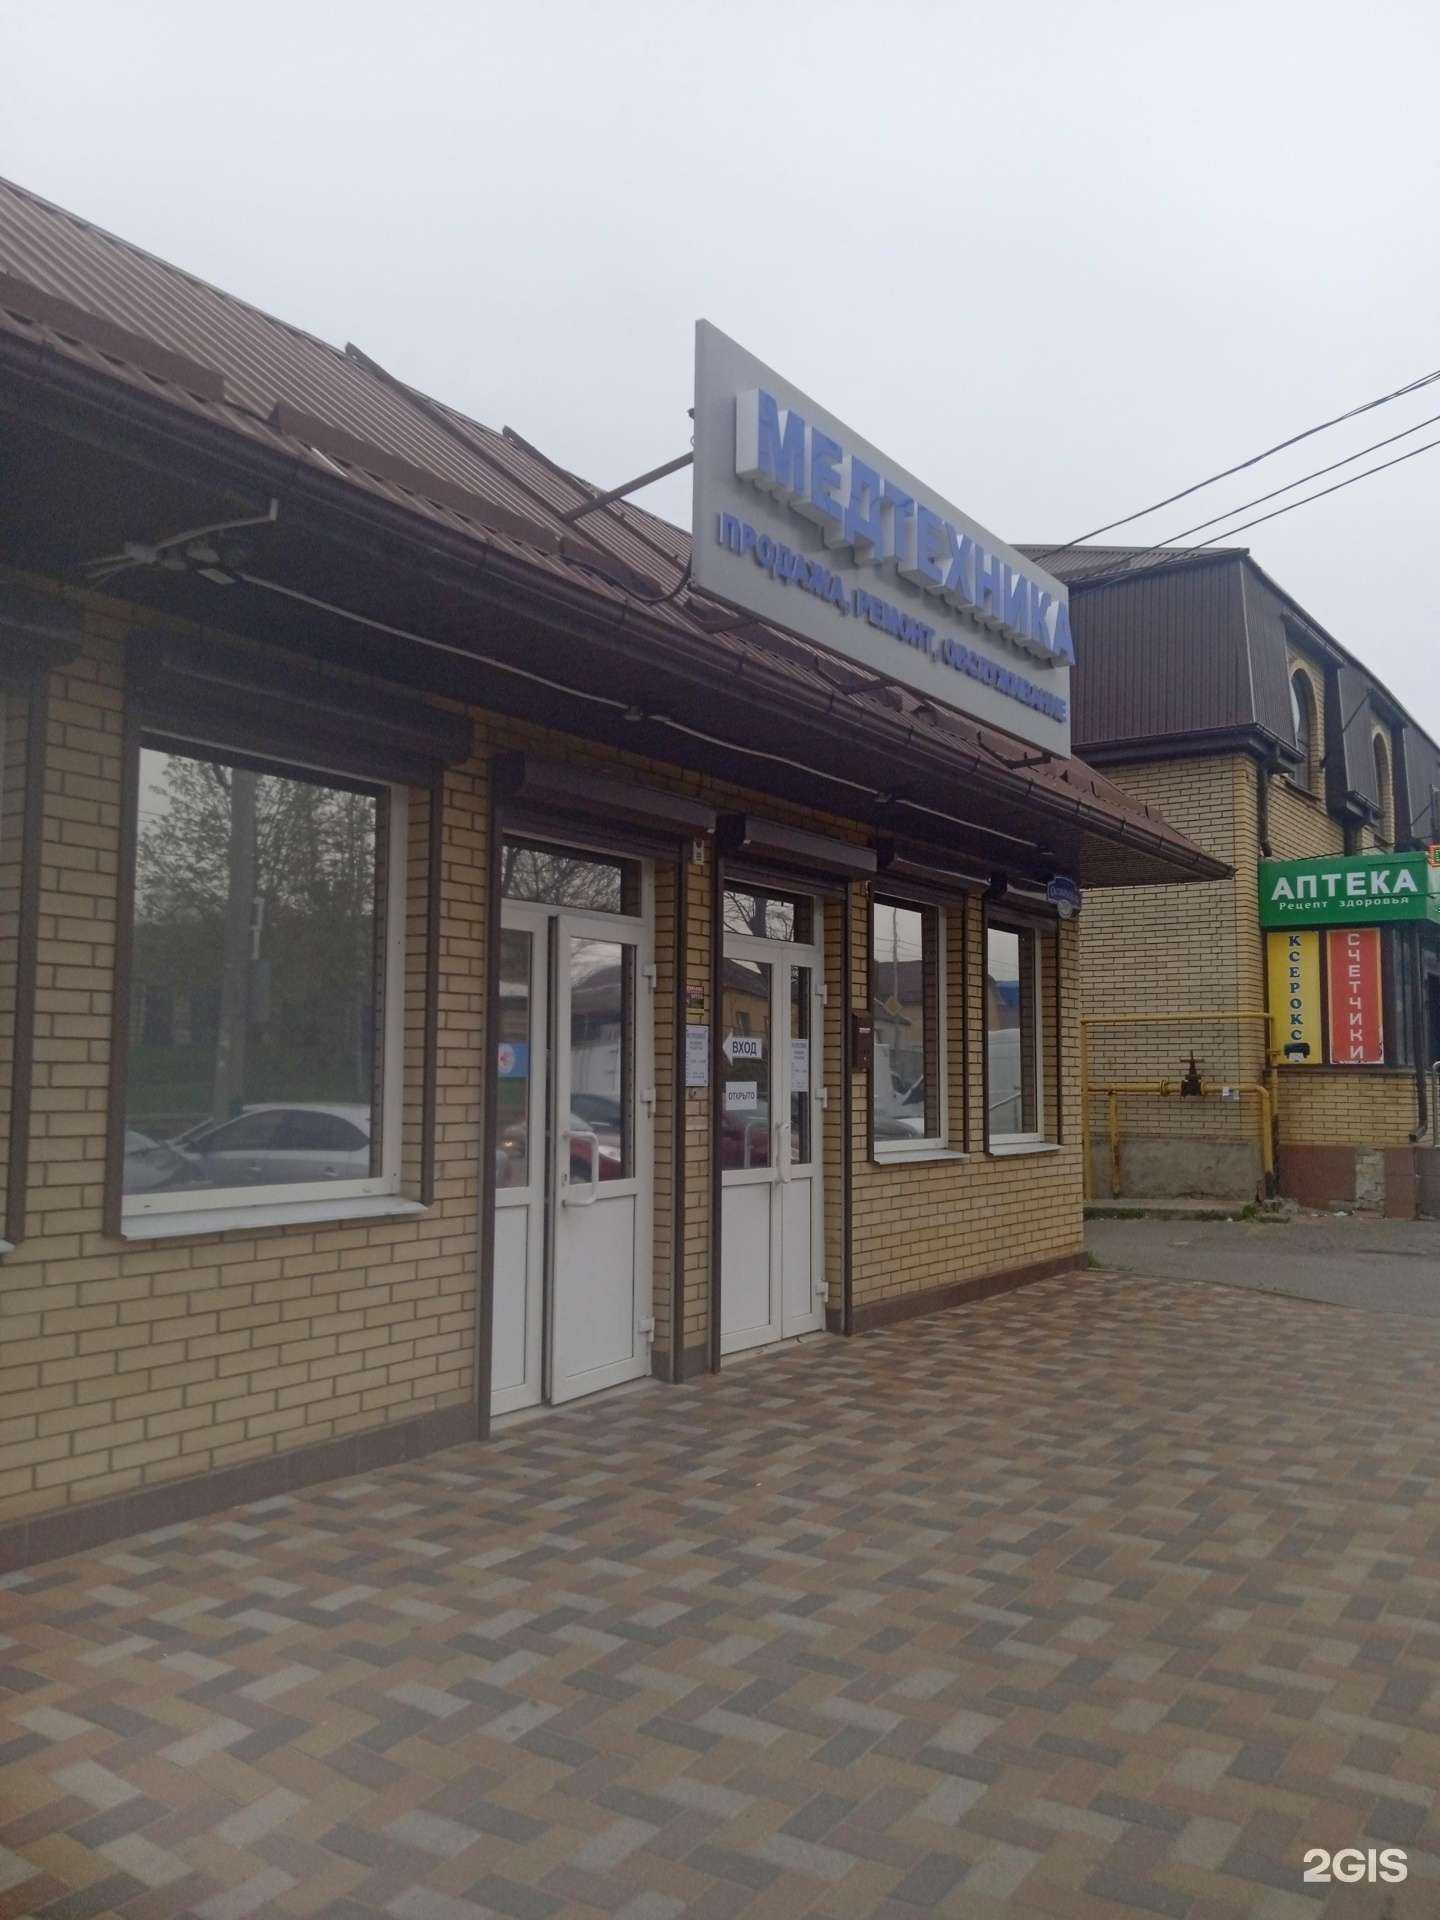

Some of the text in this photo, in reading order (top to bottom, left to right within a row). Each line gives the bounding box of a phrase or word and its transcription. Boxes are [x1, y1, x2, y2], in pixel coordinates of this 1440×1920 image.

[754, 387, 1076, 667] МЕДТЕХНИКА
[1271, 868, 1418, 900] АПТЕКА
[1279, 896, 1409, 911] Рецепт здоровья
[1288, 935, 1304, 1041] КСЕРОКС
[1346, 932, 1364, 1060] СЧЕТЧИКИ
[732, 1041, 757, 1056] ВХОД
[728, 1091, 756, 1101] ОТКРЫТО
